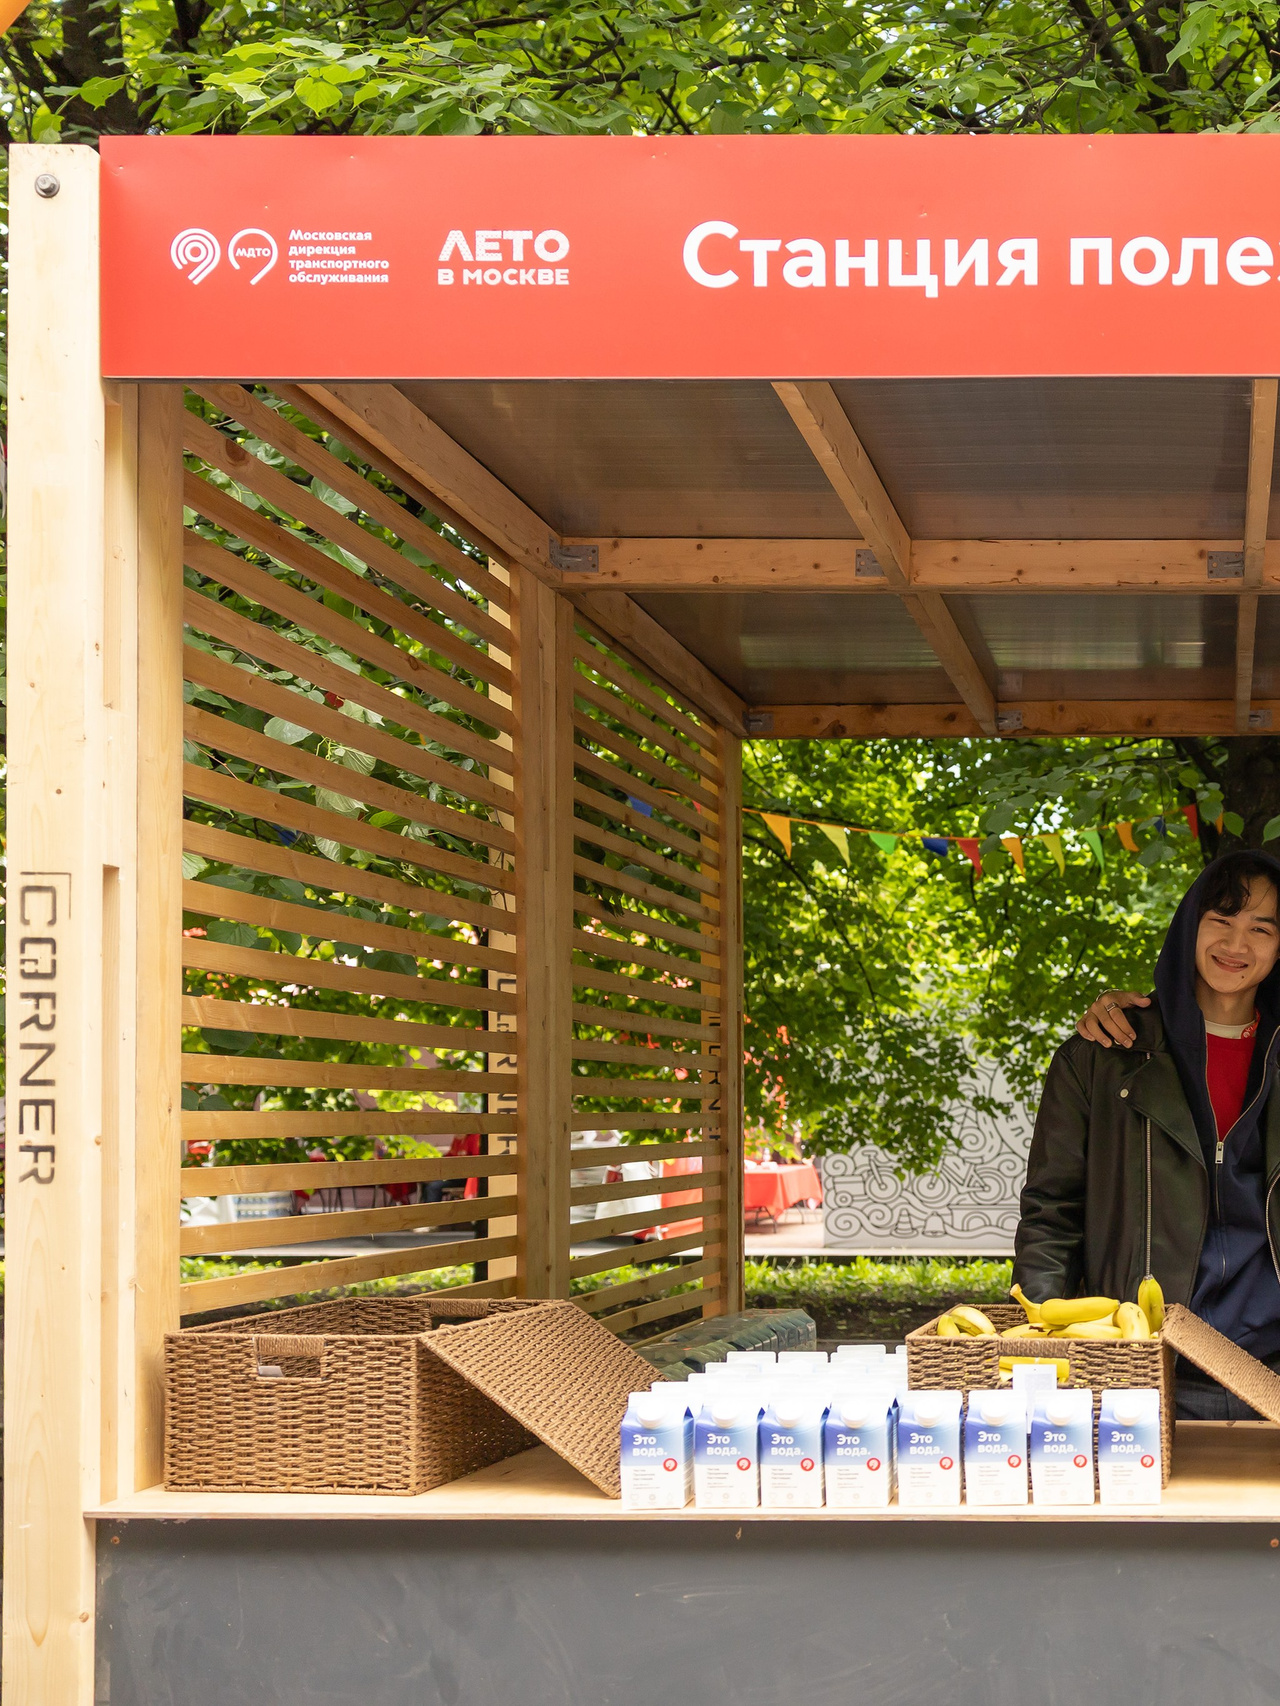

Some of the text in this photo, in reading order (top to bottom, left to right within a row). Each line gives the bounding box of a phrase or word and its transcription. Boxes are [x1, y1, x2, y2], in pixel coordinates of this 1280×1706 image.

[288, 229, 372, 241] Московская
[288, 245, 356, 255] дирекция
[438, 229, 570, 262] ЛЕТО
[235, 247, 271, 258] МДТО
[682, 220, 1038, 298] Станция
[288, 259, 390, 271] транспортного
[288, 272, 389, 285] обслуживания
[437, 268, 570, 286] В МОСКВЕ
[633, 1434, 656, 1446] Это
[706, 1433, 730, 1444] Это
[771, 1434, 794, 1445] Это
[836, 1434, 860, 1445] Это
[910, 1433, 933, 1444] Это
[977, 1431, 1001, 1442] Это
[1043, 1431, 1066, 1442] Это
[1110, 1431, 1134, 1442] Это
[632, 1447, 668, 1456] вода.
[706, 1446, 741, 1456] вода.
[771, 1446, 804, 1456] вода.
[836, 1447, 871, 1456] вода.
[910, 1445, 944, 1456] вода.
[977, 1443, 1012, 1454] вода.
[1043, 1444, 1078, 1454] вода.
[1110, 1444, 1144, 1454] вода.
